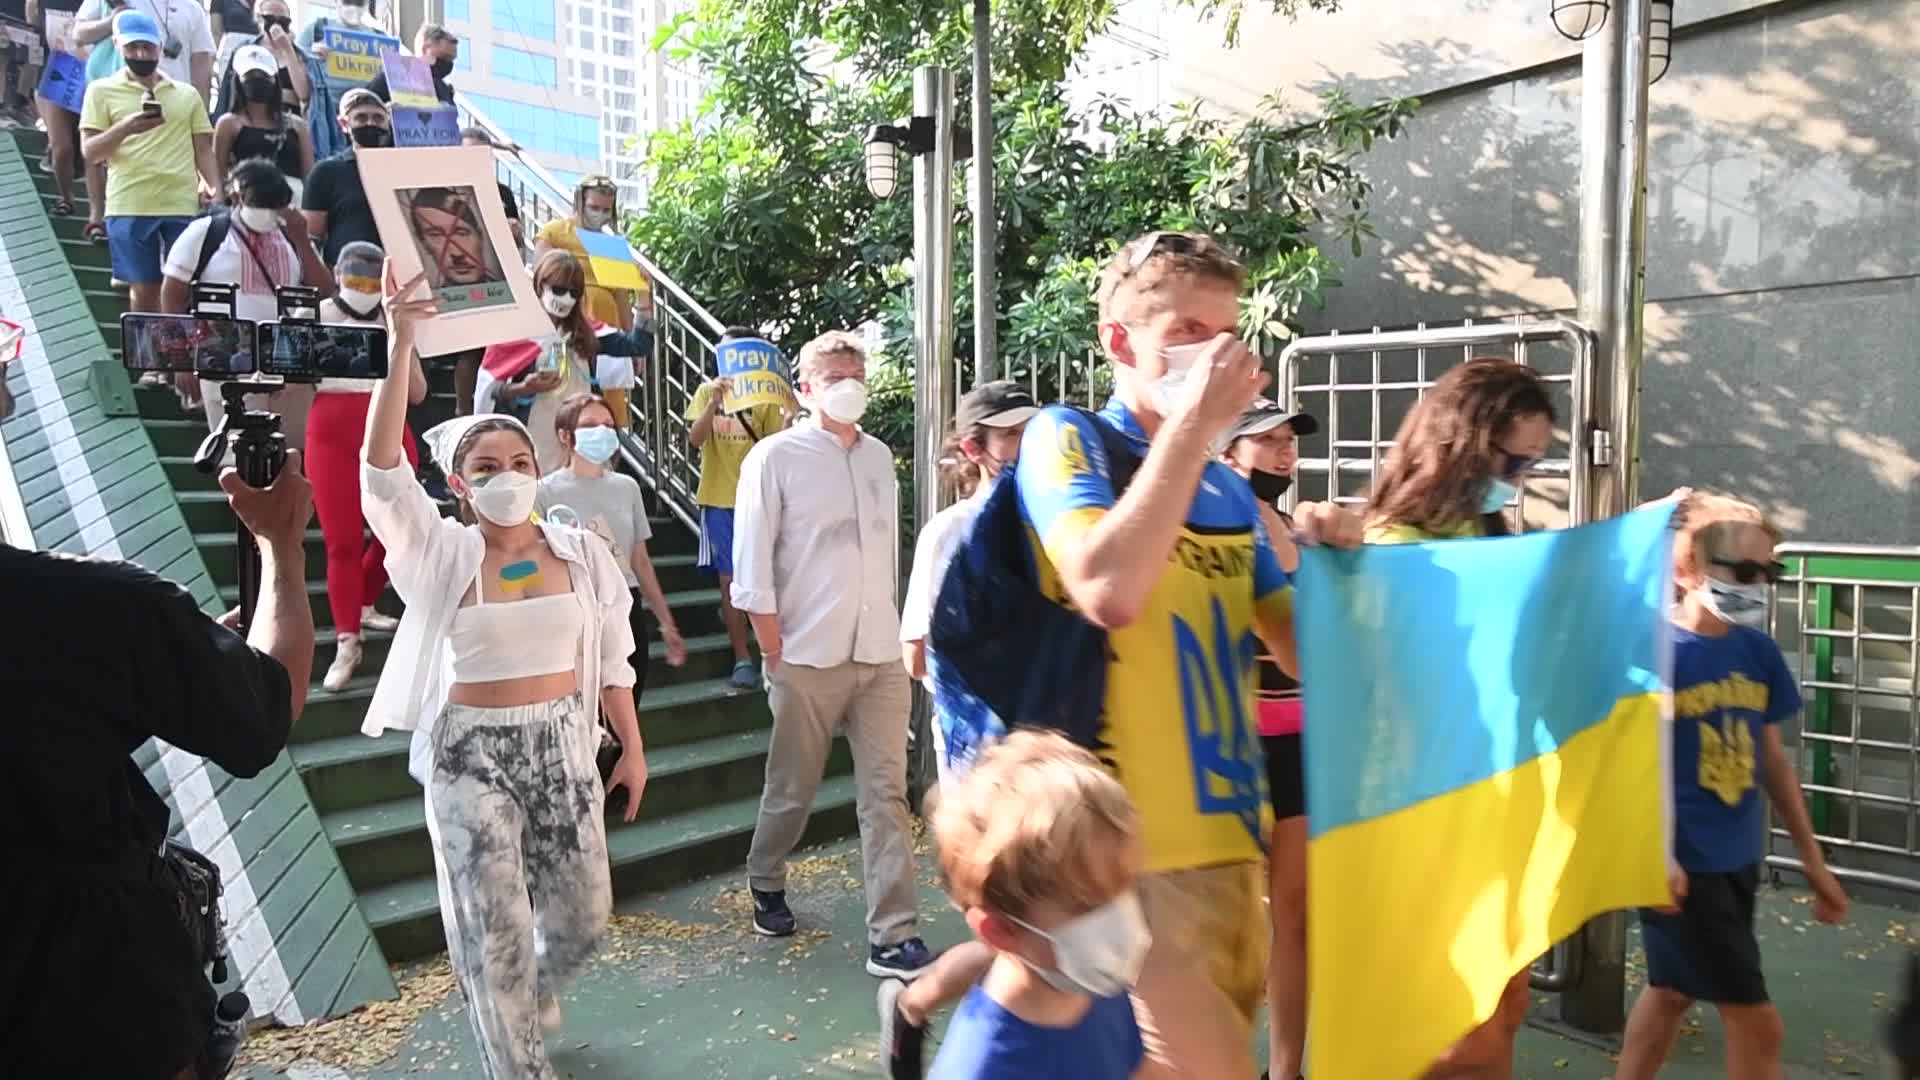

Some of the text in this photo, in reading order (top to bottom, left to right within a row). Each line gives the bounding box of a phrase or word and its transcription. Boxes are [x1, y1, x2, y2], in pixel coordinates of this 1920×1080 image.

[332, 31, 368, 56] Pray
[336, 55, 384, 73] Ukrai
[399, 128, 430, 139] PRAY
[725, 347, 770, 371] Pray
